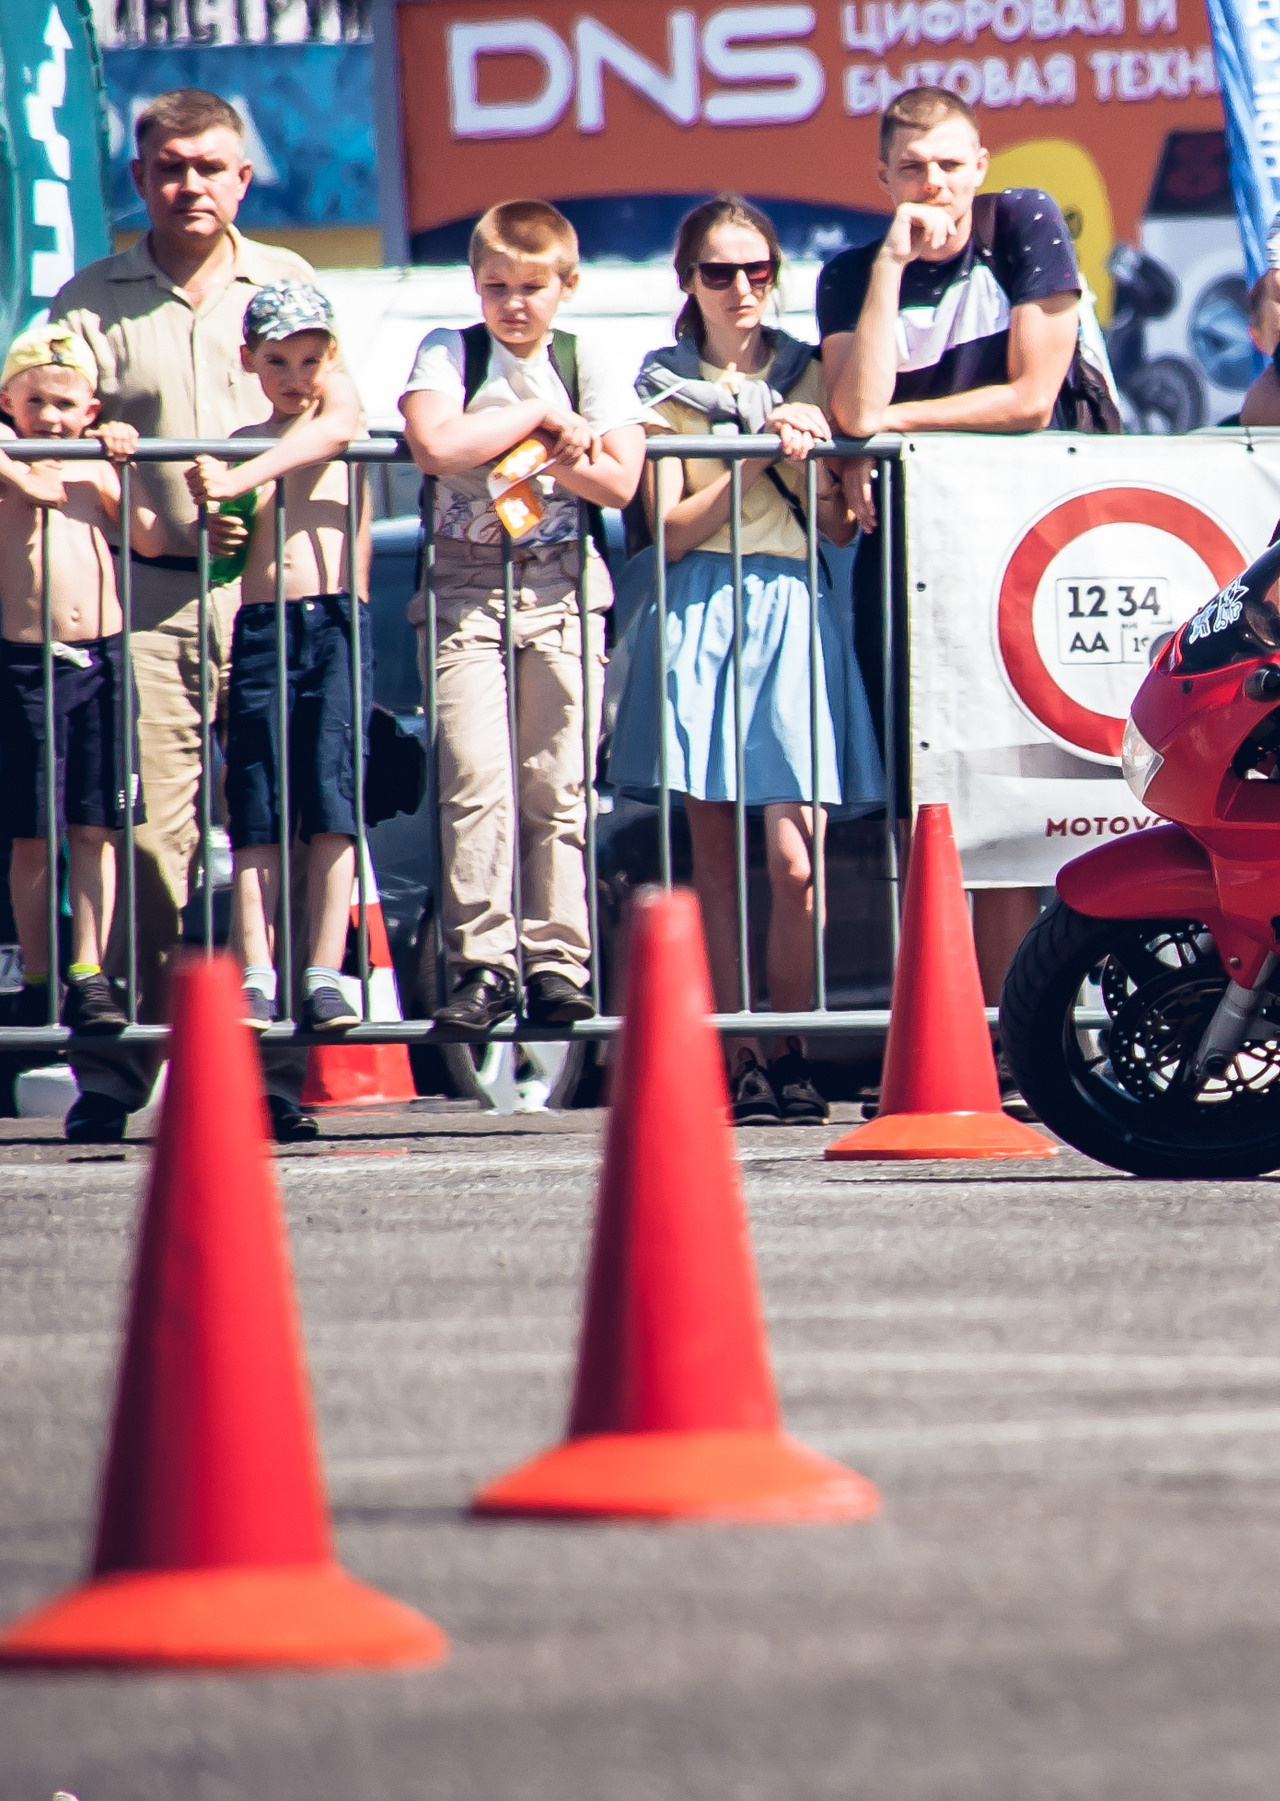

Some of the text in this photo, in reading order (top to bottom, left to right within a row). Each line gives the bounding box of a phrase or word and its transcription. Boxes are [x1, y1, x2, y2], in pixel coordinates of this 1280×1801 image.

[449, 5, 823, 138] DNS
[1068, 585, 1161, 618] 12 34
[1045, 816, 1174, 837] MOTOV
